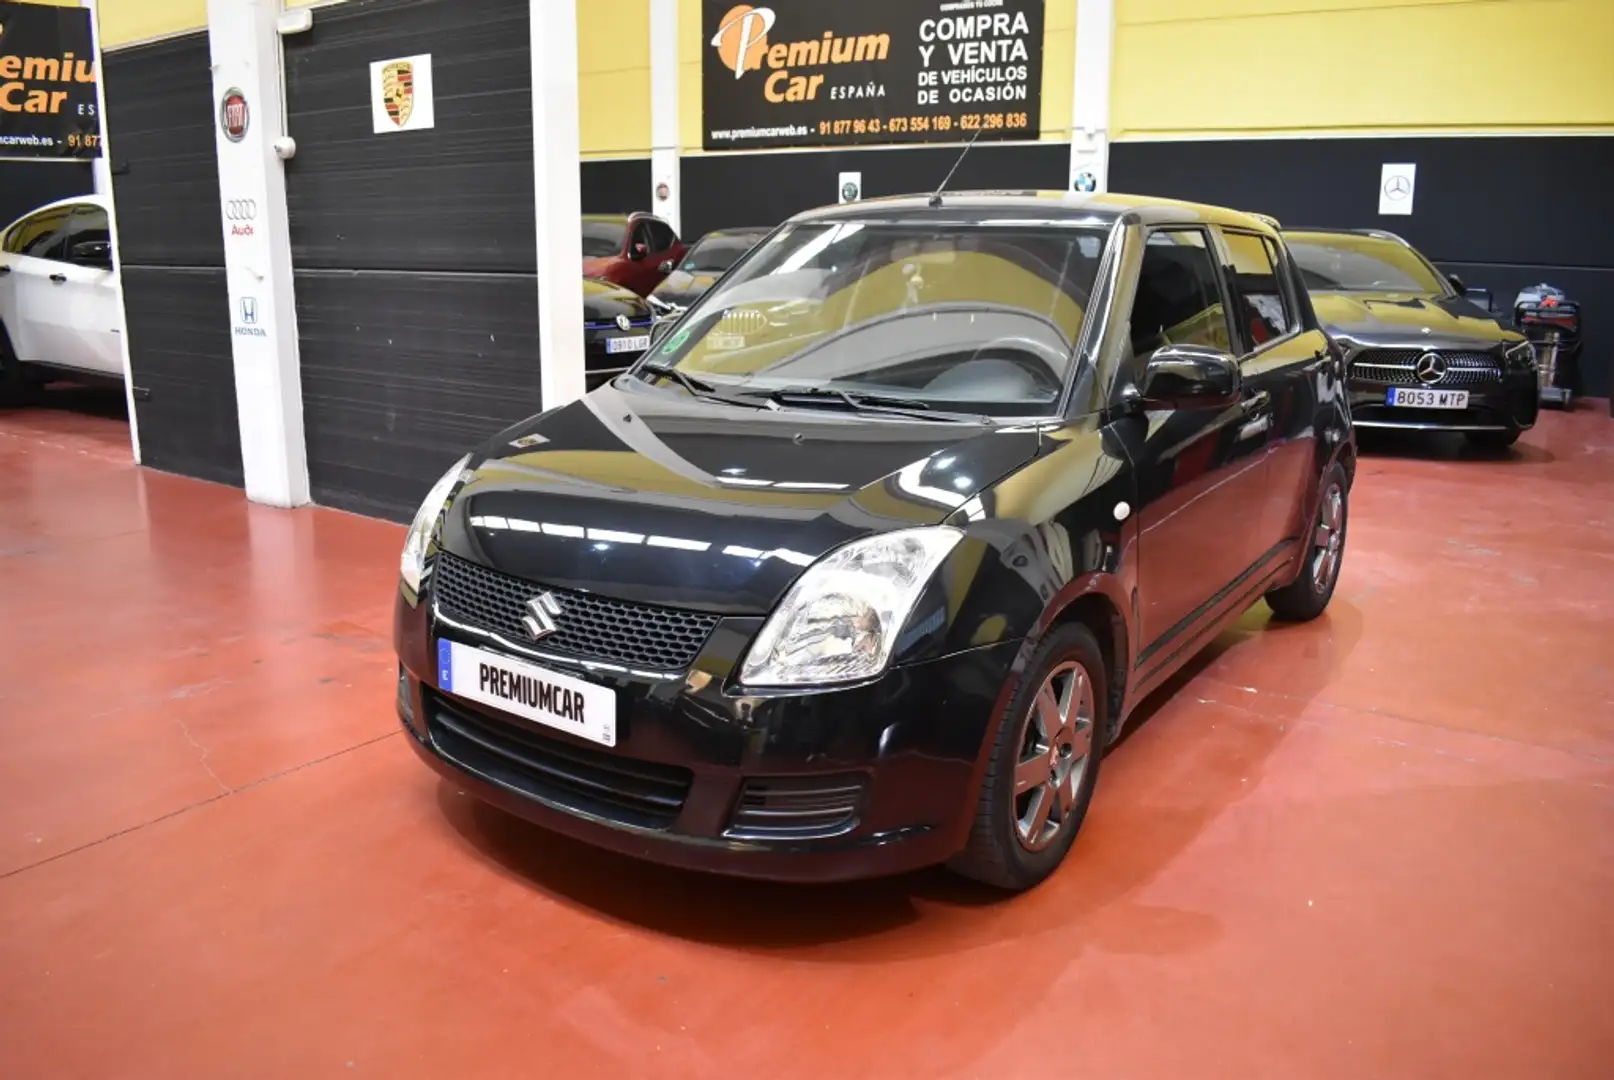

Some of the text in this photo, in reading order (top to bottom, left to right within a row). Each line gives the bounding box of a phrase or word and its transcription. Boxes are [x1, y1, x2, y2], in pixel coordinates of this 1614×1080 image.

[919, 11, 1029, 42] COMPRA
[711, 7, 890, 80] Premium
[918, 38, 1028, 67] Y VENTA
[764, 70, 886, 103] Car ESPAÑA
[918, 65, 1027, 86] DE VEHÍCULOS
[0, 81, 68, 114] Car
[917, 82, 1027, 104] DE OCASIÓN
[67, 134, 81, 147] 91
[711, 125, 808, 141] www.premiumcarweb.es
[819, 121, 831, 135] 91
[833, 120, 851, 135] 877
[853, 119, 866, 134] 96
[868, 118, 881, 133] 43
[889, 117, 908, 132] 673
[910, 116, 930, 131] 554
[932, 115, 951, 131] 169
[960, 114, 980, 130] 622
[983, 113, 1004, 129] 296
[1005, 112, 1028, 128] 836
[231, 224, 254, 236] Audi
[234, 326, 266, 337] HONDA
[1397, 391, 1465, 406] 8053 MTP
[479, 662, 585, 724] PREMIUMCAR
